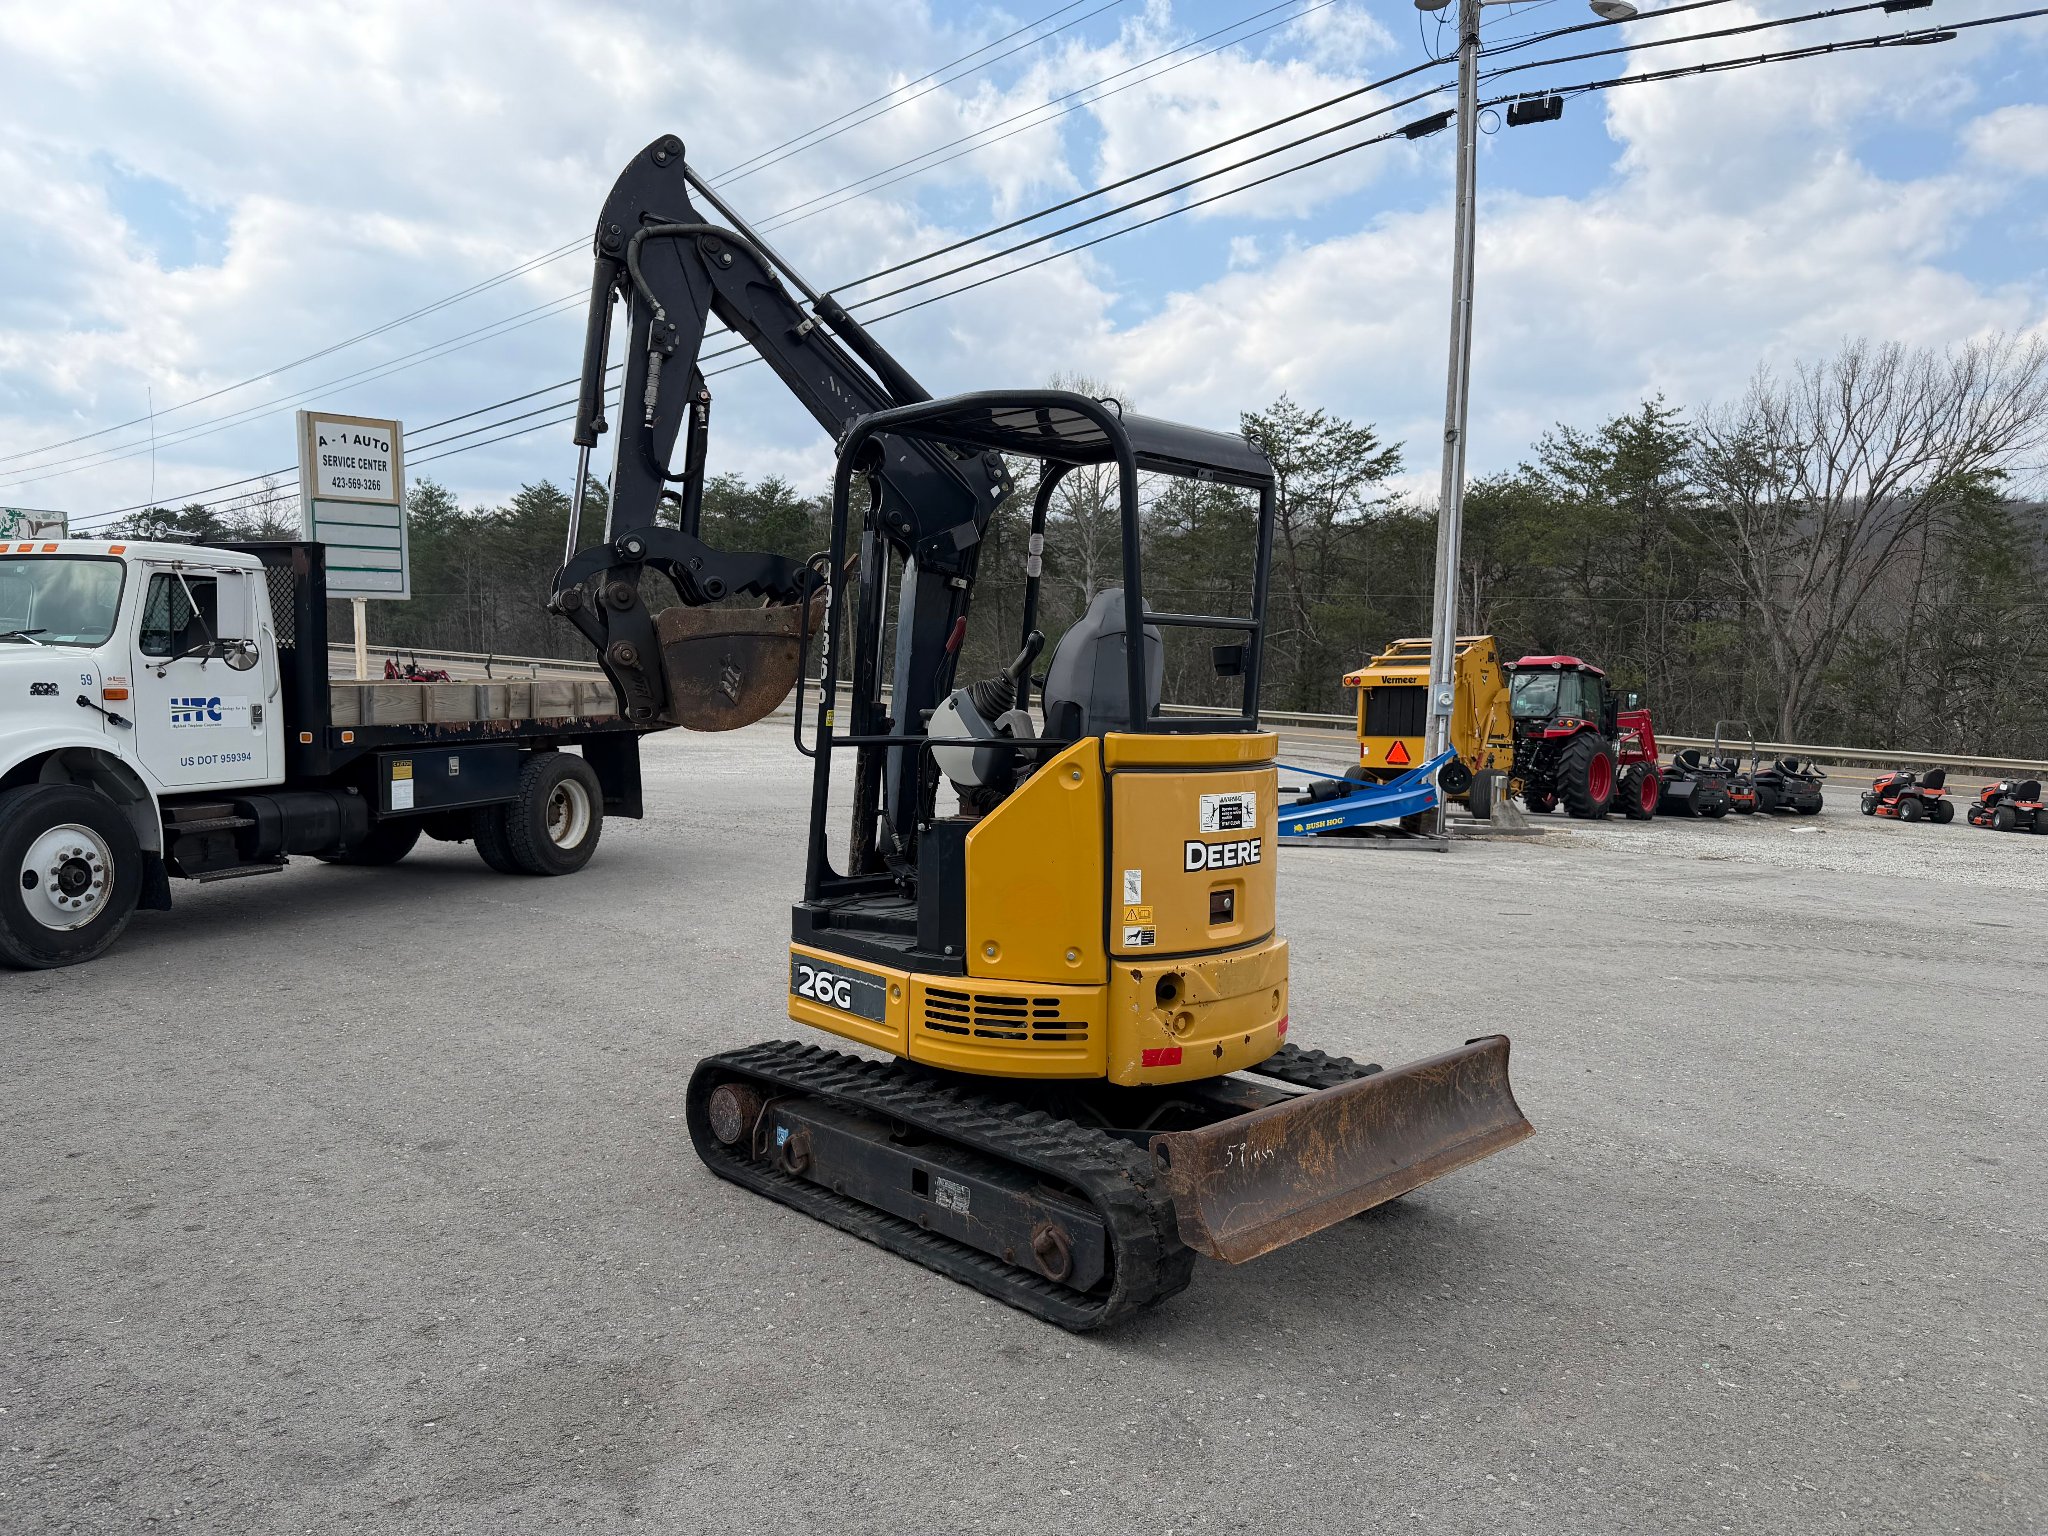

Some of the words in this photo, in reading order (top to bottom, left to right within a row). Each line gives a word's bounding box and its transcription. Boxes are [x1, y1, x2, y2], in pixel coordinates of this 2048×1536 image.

[319, 435, 328, 447] A
[341, 433, 347, 444] 1
[353, 434, 389, 453] AUTO
[322, 454, 356, 468] SERVICE
[358, 458, 387, 472] CENTER
[332, 477, 381, 491] 423-569-3266
[80, 674, 93, 686] 59
[1381, 675, 1418, 684] Vermeer
[171, 697, 222, 722] HTC
[180, 756, 195, 767] US
[197, 754, 218, 765] DOT
[220, 752, 251, 764] 959394
[1305, 821, 1326, 831] BUSH
[1326, 817, 1343, 827] HOG
[1184, 837, 1261, 873] DEERE
[799, 964, 851, 1009] 26G
